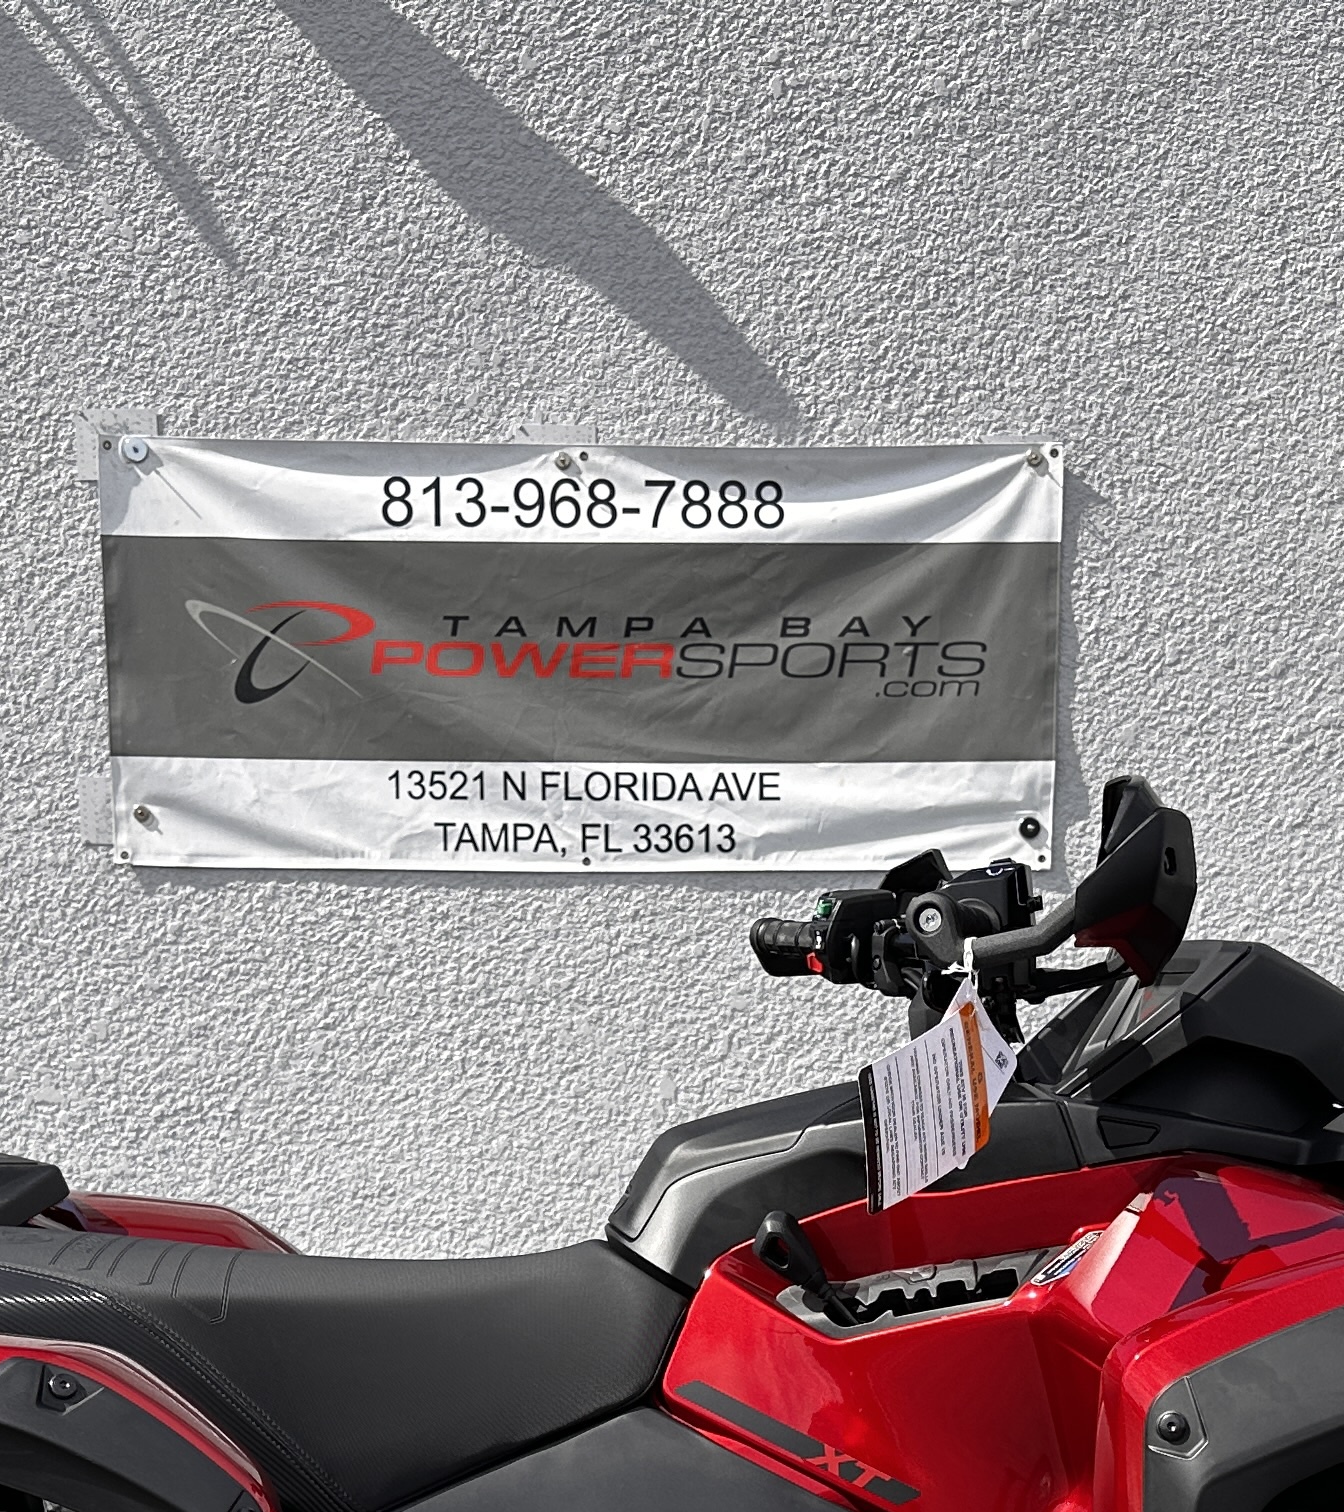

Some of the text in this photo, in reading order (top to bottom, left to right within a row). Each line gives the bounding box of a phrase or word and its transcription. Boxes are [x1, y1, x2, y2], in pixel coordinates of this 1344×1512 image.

[381, 476, 786, 529] 813-968-7888
[443, 615, 932, 638] TAMPA BAY
[370, 640, 988, 680] POWERSPORTS
[875, 678, 980, 699] .com
[387, 770, 782, 801] 13521 N FLORIDA AVE
[434, 823, 736, 858] TAMPA, FL 33613
[805, 1443, 893, 1488] XT
